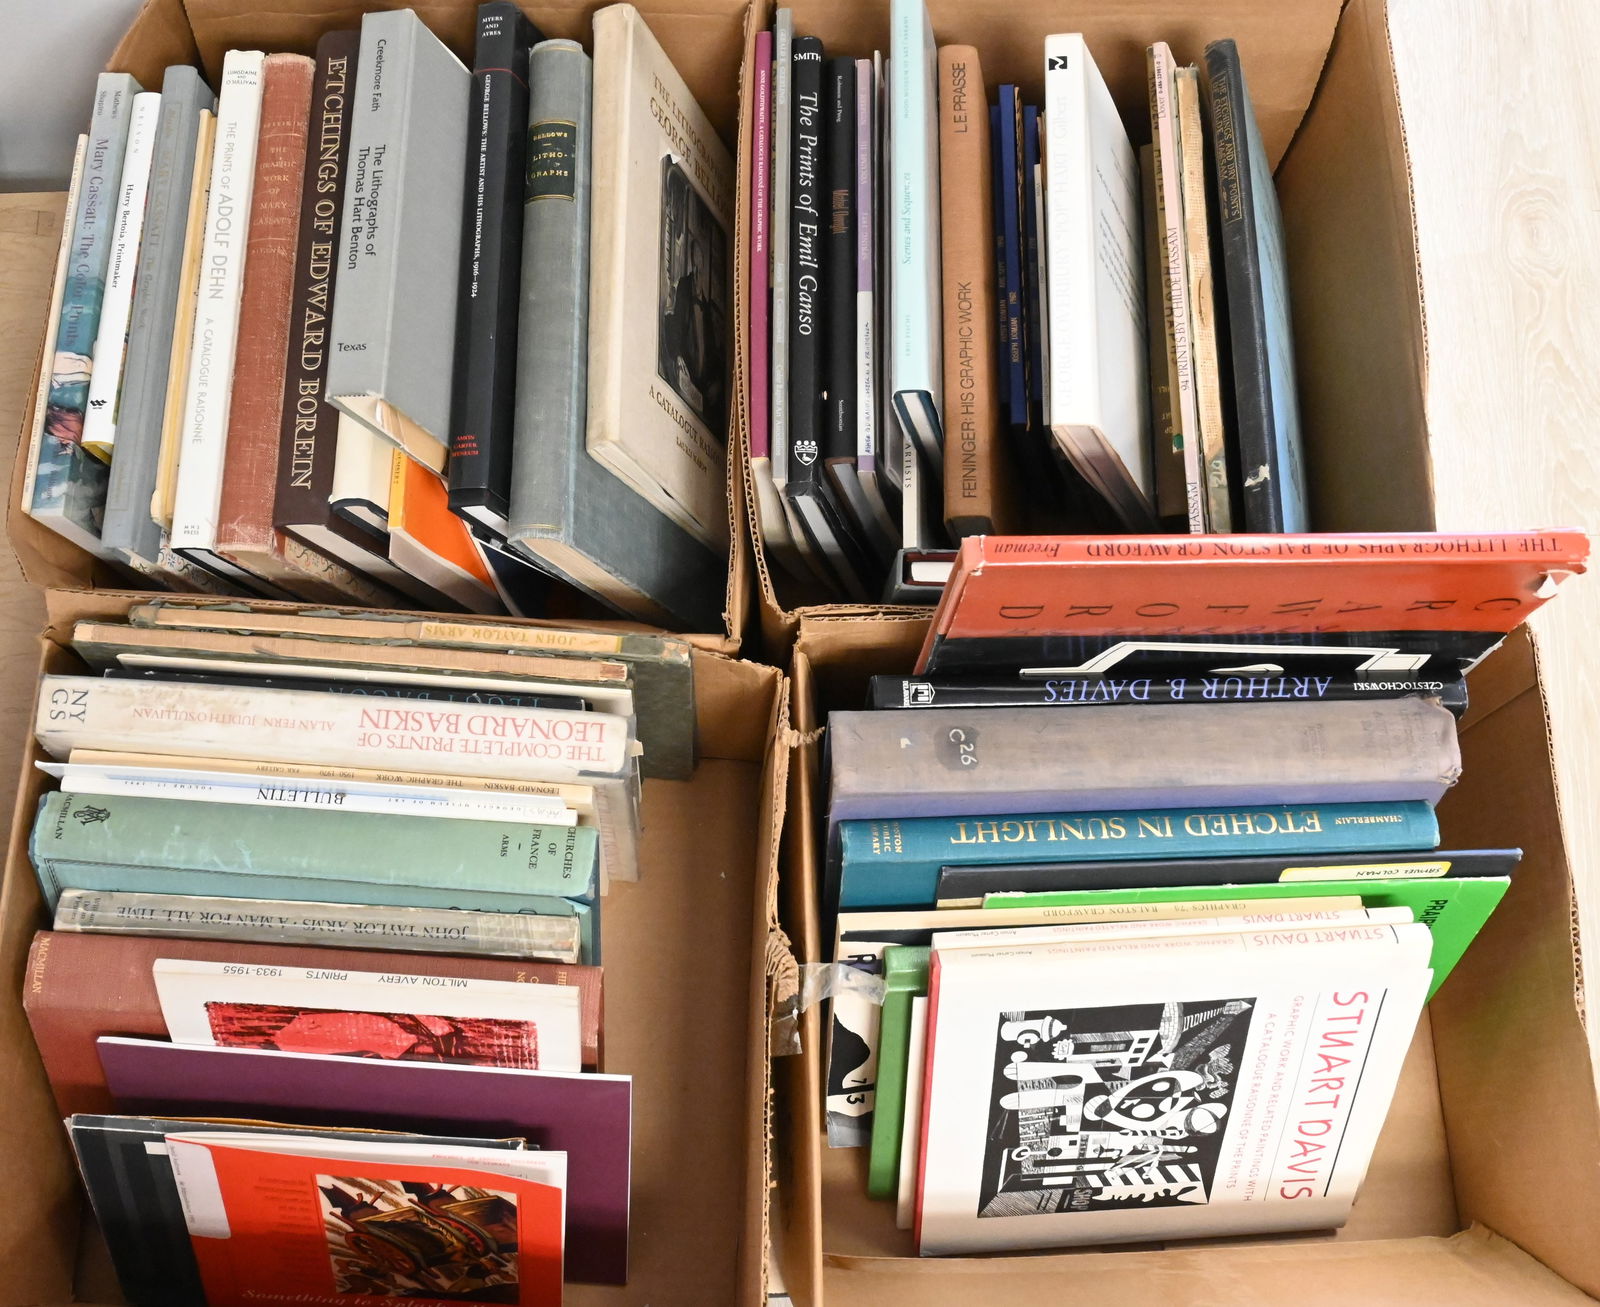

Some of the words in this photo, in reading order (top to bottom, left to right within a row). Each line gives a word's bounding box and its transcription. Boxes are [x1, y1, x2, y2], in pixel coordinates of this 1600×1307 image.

[482, 15, 503, 24] MYERS
[484, 22, 499, 30] AND
[373, 38, 388, 92] Creekmore
[794, 52, 822, 62] SMITH
[653, 73, 671, 108] THE
[1220, 78, 1228, 94] THE
[371, 94, 382, 112] Fath
[800, 92, 818, 126] The
[317, 56, 348, 193] ETCHINGS
[482, 104, 490, 136] BELLOWS:
[1214, 98, 1222, 134] CHILDE
[1220, 95, 1232, 141] ETCHINGS
[227, 121, 238, 140] THE
[532, 131, 568, 141] BELLOWS
[650, 96, 694, 168] GEORGE
[94, 138, 109, 173] Mary
[222, 142, 234, 173] PRINTS
[375, 144, 386, 164] The
[800, 135, 818, 187] Prints
[1225, 142, 1234, 160] AND
[263, 174, 290, 182] WORK
[356, 146, 370, 194] Thomas
[531, 170, 569, 180] GRAPHS
[1227, 162, 1236, 180] DRY
[220, 177, 230, 190] OF
[83, 176, 104, 230] Cassatt:
[124, 183, 134, 207] Harry
[365, 168, 385, 240] Lithographs
[1229, 184, 1240, 216] POINTS
[352, 196, 365, 225] Hart
[794, 194, 818, 217] of
[120, 209, 130, 241] Bertoia,
[214, 193, 234, 249] ADOLF
[313, 204, 336, 235] OF
[901, 218, 912, 235] and
[473, 208, 483, 260] LITHOGRAPHS,
[80, 234, 95, 259] The
[348, 226, 362, 270] Benton
[365, 242, 376, 256] of
[799, 222, 818, 268] Emil
[902, 236, 912, 265] Scenes
[1168, 226, 1180, 275] HASSAM
[112, 243, 126, 289] Printmaker
[72, 263, 91, 298] Color
[208, 254, 228, 300] DEHN
[302, 241, 332, 371] EDWARD
[798, 274, 818, 336] Ganso
[958, 280, 972, 324] WORK
[1172, 277, 1184, 318] CHILDE
[62, 304, 84, 347] Prints
[205, 317, 214, 326] A
[1175, 322, 1185, 334] BY
[338, 342, 367, 352] Texas
[1176, 337, 1189, 377] PRINTS
[198, 328, 214, 388] CATALOGUE
[958, 326, 974, 390] GRAPHIC
[1180, 380, 1190, 391] 94
[960, 392, 975, 416] HIS
[648, 384, 655, 398] A
[656, 390, 699, 445] CATALOGUE
[290, 378, 320, 490] BOREIN
[961, 417, 977, 499] FEININGER:
[1187, 482, 1201, 532] HASSAM
[994, 542, 1060, 558] Freeman
[1087, 543, 1202, 558] CRAWFORD
[1213, 541, 1312, 558] RALSTON
[1324, 542, 1348, 556] OF
[1360, 539, 1507, 555] LITHOGRAPHS
[1519, 538, 1562, 552] THE
[425, 624, 470, 640] ARMS
[473, 627, 527, 645] TAYLOR
[536, 633, 577, 647] JOHN
[1044, 679, 1150, 702] DAVIES
[1166, 678, 1186, 699] B.
[1201, 676, 1332, 700] ARTHUR
[1354, 681, 1444, 691] CZESTOCHOWSKI
[49, 688, 70, 721] GS
[68, 690, 88, 724] NY
[132, 708, 208, 726] O'SULLIVAN
[210, 712, 257, 727] JUDITH
[263, 717, 296, 731] FERN
[296, 719, 336, 732] ALAN
[360, 707, 460, 732] BASKIN
[466, 714, 605, 743] LEONARD
[357, 732, 382, 748] OF
[386, 734, 454, 756] PRINTS
[459, 736, 561, 760] COMPLETE
[565, 745, 604, 763] THE
[376, 774, 404, 784] WORK
[404, 775, 444, 787] GRAPHIC
[445, 778, 463, 788] THE
[484, 782, 515, 792] BASKIN
[518, 783, 560, 795] LEONARD
[256, 788, 344, 806] BULLETIN
[55, 794, 74, 840] MACMILLAN
[1184, 810, 1324, 837] ETCHED
[1335, 814, 1403, 826] CHAMBERLAIN
[950, 817, 1127, 845] SUNLIGHT
[1138, 816, 1174, 839] IN
[500, 834, 510, 858] ARMS
[528, 828, 542, 870] FRANCE
[548, 843, 558, 856] OF
[562, 827, 577, 880] CHURCHES
[1356, 868, 1400, 878] COLMAN
[1404, 867, 1442, 877] SAMUEL
[116, 906, 155, 920] TIME
[165, 909, 194, 922] ALL
[1042, 908, 1105, 918] CRAWFORD
[1108, 906, 1158, 916] RALSTON
[1190, 903, 1246, 911] GRAPHICS
[1293, 911, 1340, 922] STUART
[200, 912, 231, 925] FOR
[237, 914, 274, 928] MAN
[278, 917, 288, 928] A
[302, 918, 348, 934] ARMS
[1242, 914, 1290, 926] DAVIS
[352, 922, 418, 938] TAYLOR
[422, 926, 468, 941] JOHN
[1252, 932, 1310, 947] DAVIS
[1314, 927, 1384, 944] STUART
[1047, 946, 1098, 954] PAINTINGS
[1100, 944, 1138, 952] RELATED
[1191, 938, 1234, 948] GRAPHIC
[32, 937, 51, 994] MACMILLAN
[224, 966, 283, 977] 1933-1955
[306, 970, 348, 982] PRINTS
[378, 974, 416, 986] AVERY
[418, 976, 468, 988] MILTON
[1268, 1012, 1276, 1020] A
[1283, 995, 1304, 1038] GRAPHIC
[1252, 1024, 1273, 1080] CATALOGUE
[1277, 1040, 1294, 1070] WORK
[1303, 991, 1369, 1108] STUART
[1271, 1071, 1288, 1092] AND
[1260, 1094, 1282, 1130] RELATED
[1240, 1128, 1251, 1140] OF
[1235, 1140, 1248, 1157] THE
[1248, 1132, 1272, 1178] PAINTINGS
[1280, 1118, 1333, 1200] DAVIS
[1224, 1160, 1242, 1190] PRINTS
[1242, 1180, 1256, 1202] WITH
